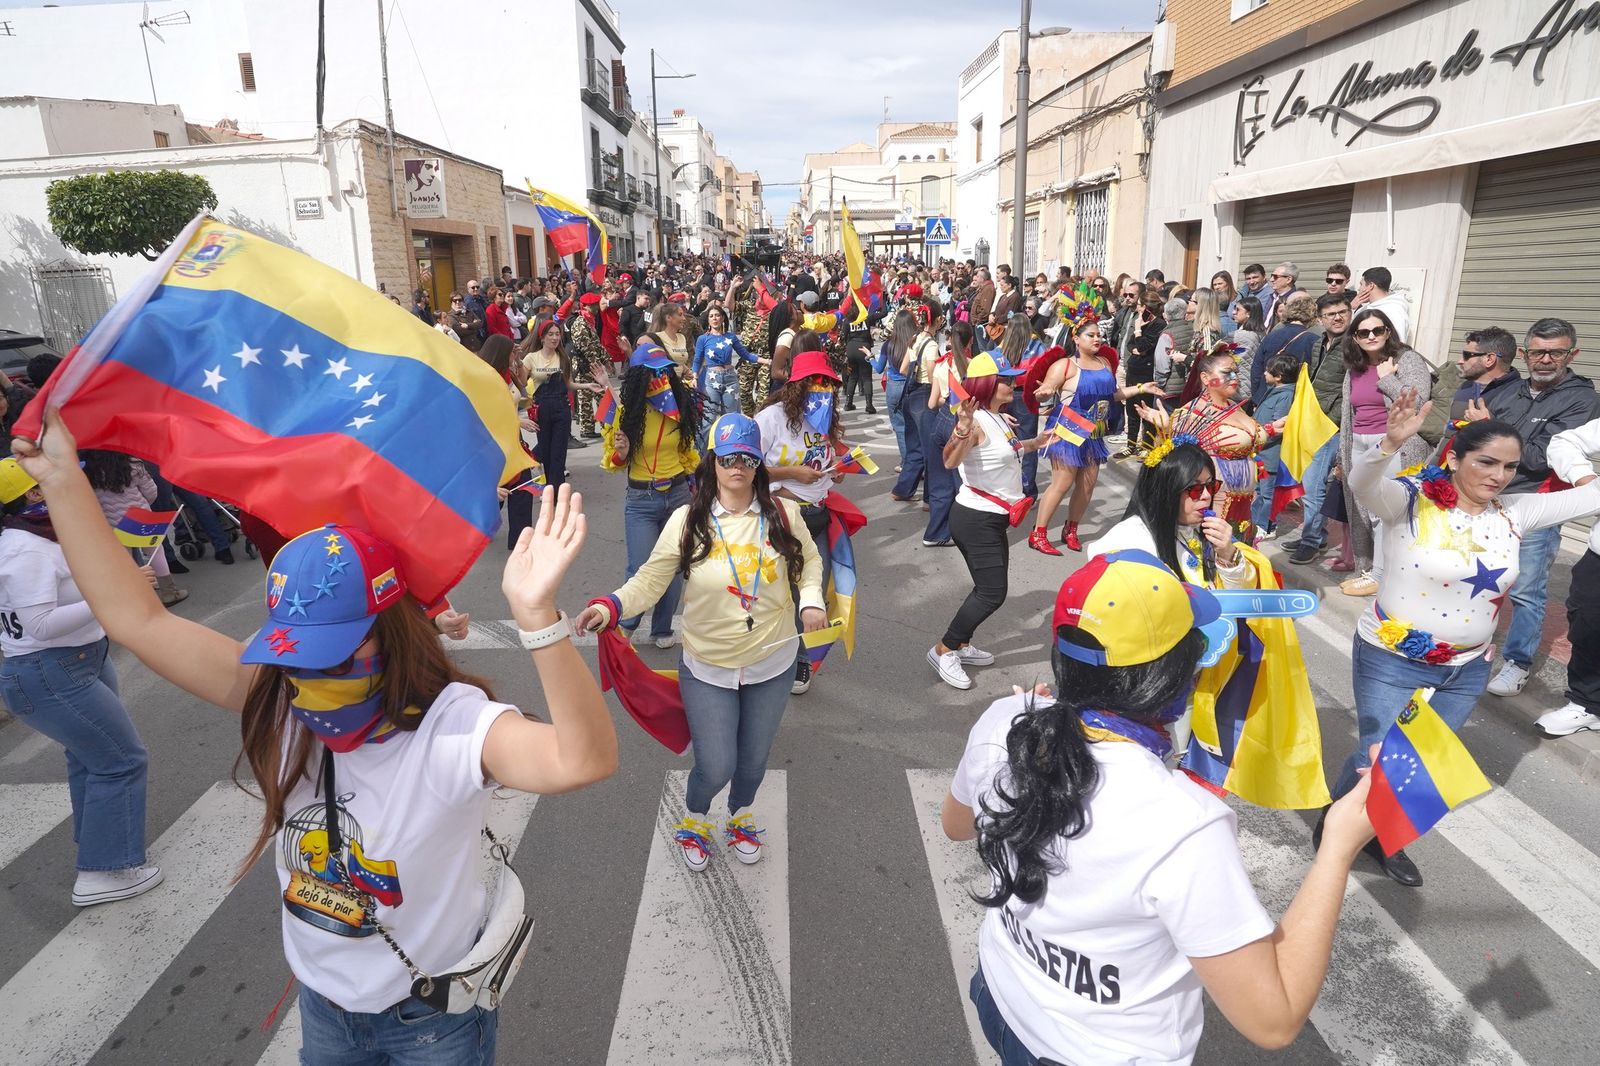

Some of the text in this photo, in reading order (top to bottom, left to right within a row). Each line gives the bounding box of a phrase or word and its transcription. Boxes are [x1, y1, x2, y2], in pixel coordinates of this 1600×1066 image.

[1271, 68, 1309, 131] La
[1307, 60, 1442, 148] Alacena
[1440, 28, 1485, 83] de
[827, 291, 840, 300] DEA
[296, 885, 355, 917] dejó de piar
